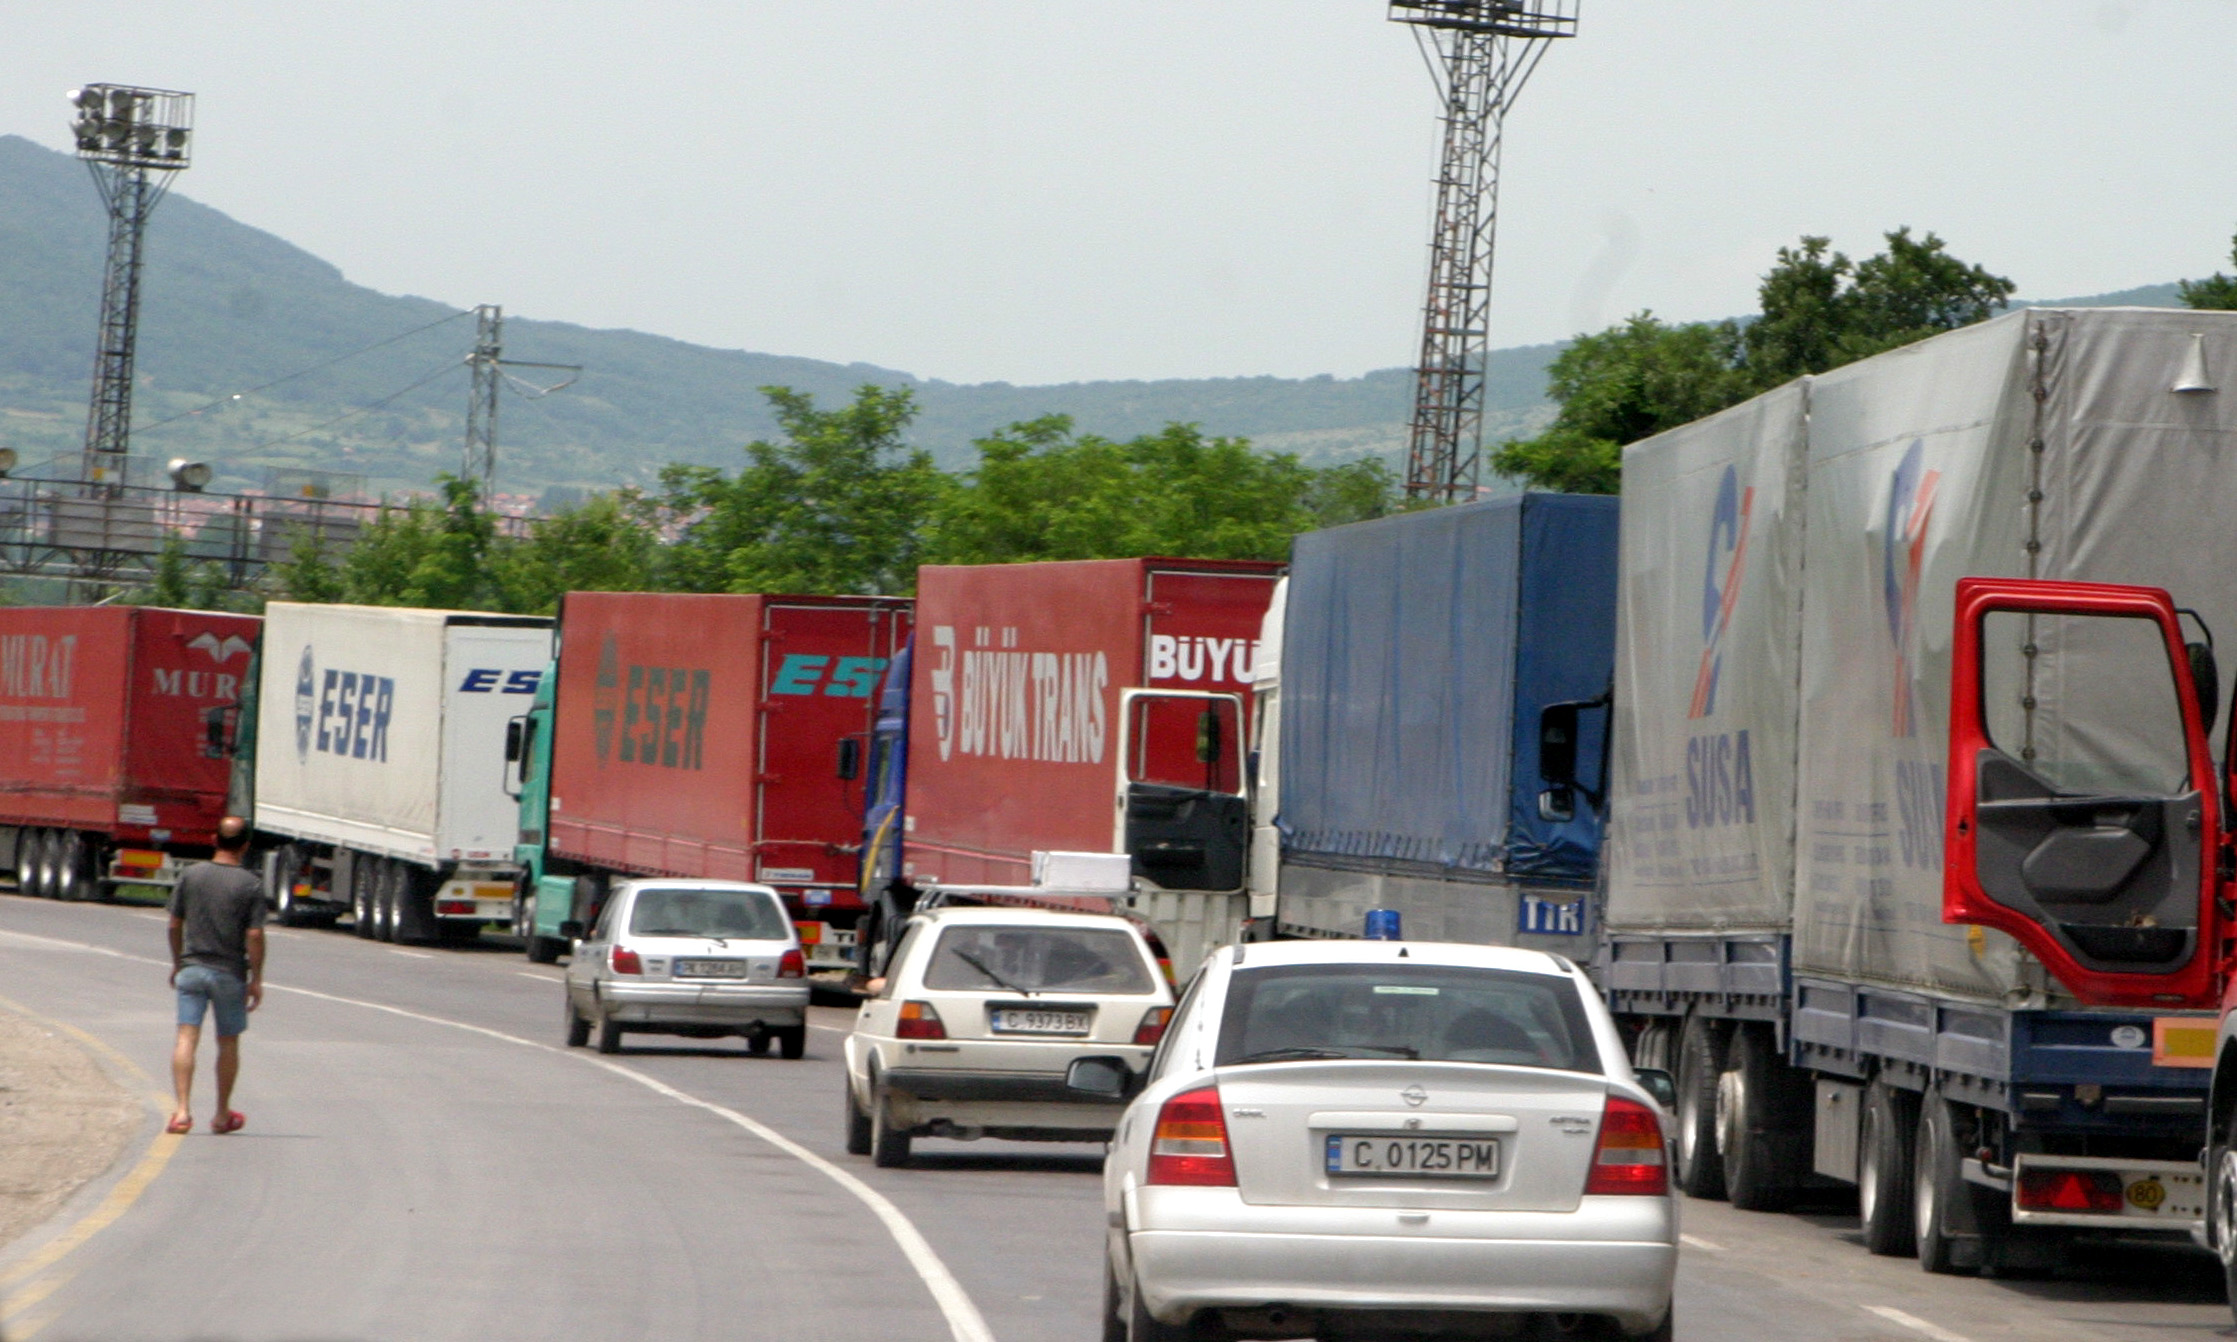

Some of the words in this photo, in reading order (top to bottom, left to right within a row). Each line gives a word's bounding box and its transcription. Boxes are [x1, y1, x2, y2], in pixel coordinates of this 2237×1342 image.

[317, 669, 394, 763] ESER
[621, 665, 711, 770] ESER
[1686, 730, 1754, 829] SUSA
[1388, 1142, 1450, 1168] 0125
[1457, 1144, 1492, 1170] PM
